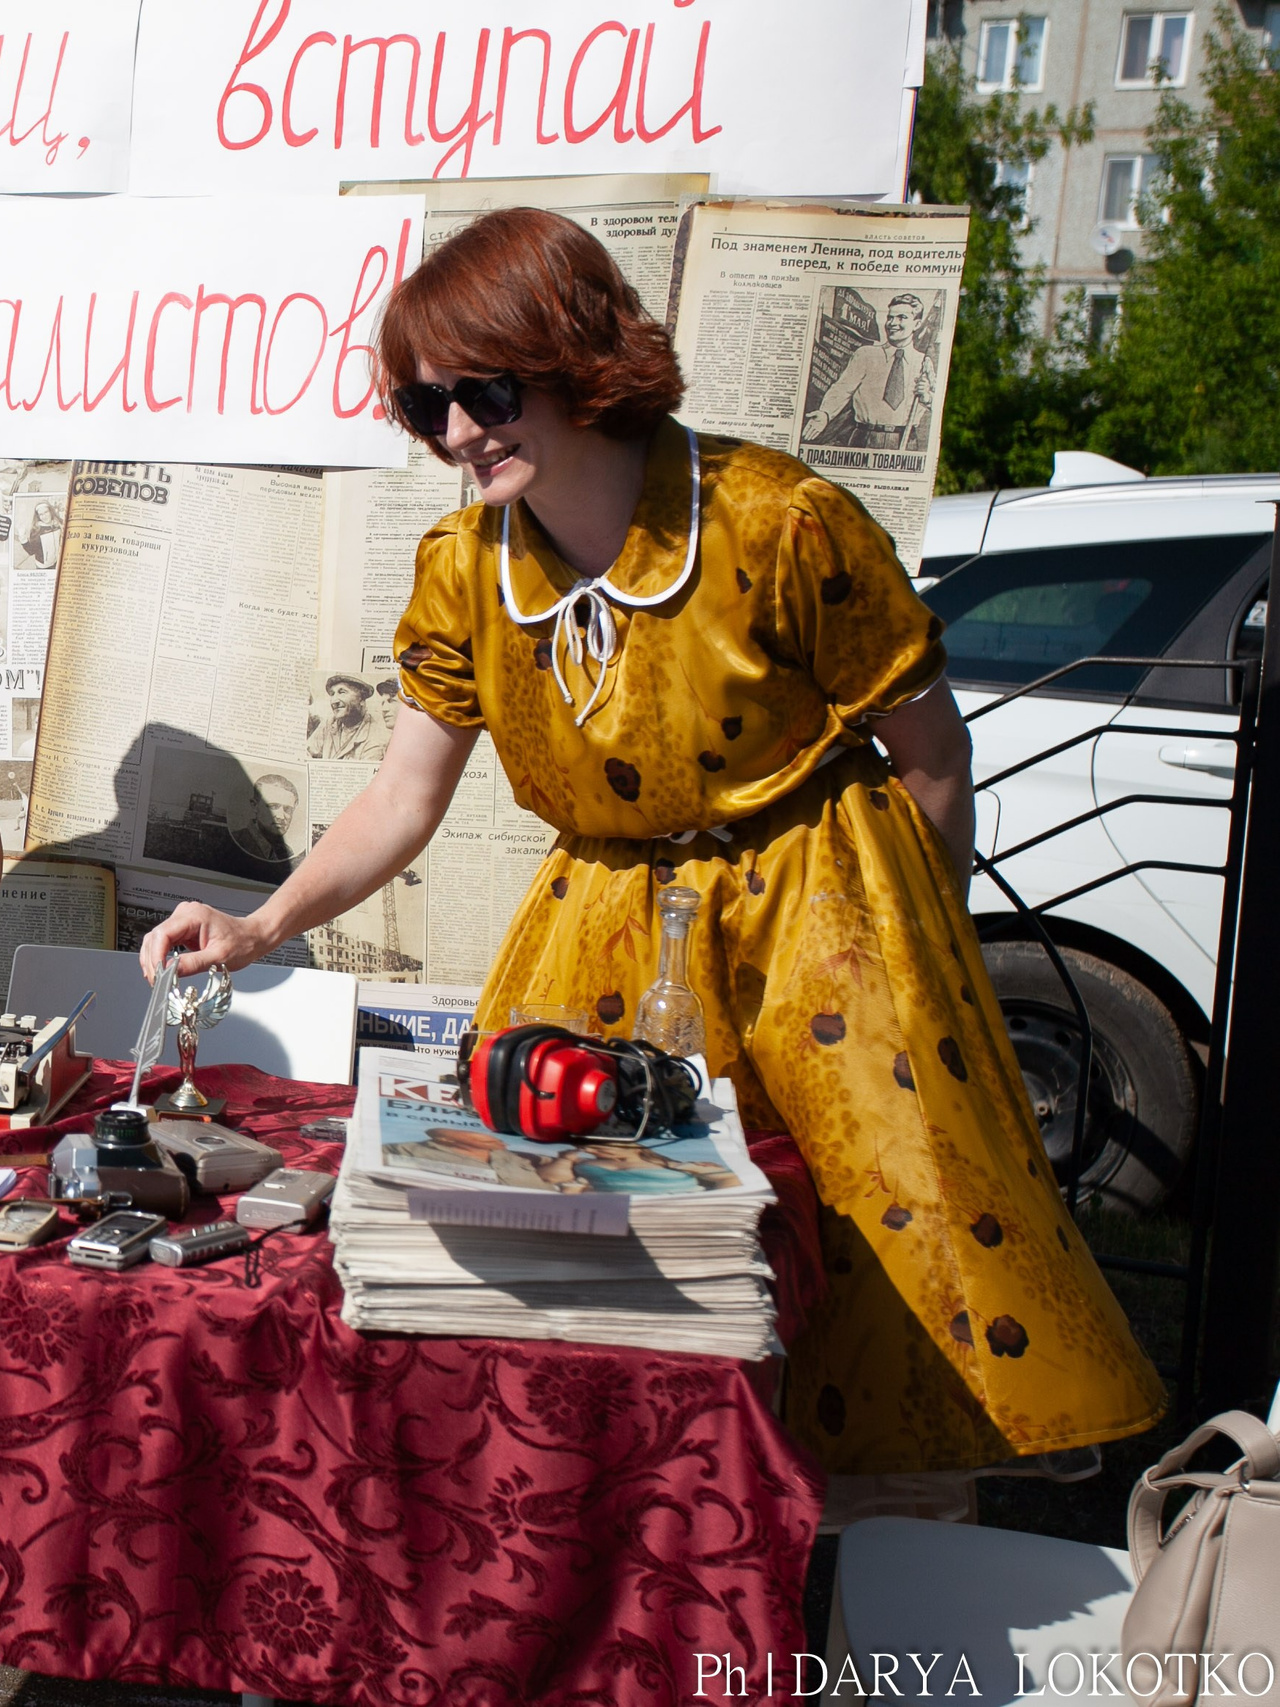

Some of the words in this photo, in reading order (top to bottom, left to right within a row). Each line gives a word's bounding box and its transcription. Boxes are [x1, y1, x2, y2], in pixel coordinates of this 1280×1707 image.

[216, 0, 723, 178] вступай
[590, 216, 598, 226] В
[603, 216, 653, 228] здоровом
[606, 226, 657, 239] здоровый
[711, 238, 738, 251] Под
[743, 242, 808, 254] знаменем
[810, 243, 864, 259] Ленина,
[868, 247, 894, 260] под
[780, 257, 831, 271] вперед,
[836, 261, 845, 271] к
[850, 261, 899, 273] победе
[728, 272, 756, 280] ответ
[806, 449, 870, 470] ПРАЗДНИКОМ,
[872, 452, 927, 473] ТОВАРИЩИ!
[73, 477, 170, 505] СОВЕТОВ
[270, 479, 301, 490] Высокая
[83, 531, 92, 539] за
[95, 533, 117, 543] вами,
[122, 537, 161, 551] товарищи
[81, 542, 140, 558] кукурузоводы
[239, 602, 261, 612] Когда
[277, 606, 299, 618] будет
[53, 754, 60, 762] Н.
[63, 756, 70, 764] С.
[441, 828, 483, 840] Экипаж
[488, 832, 547, 844] сибирской
[505, 846, 548, 856] закалки
[431, 995, 479, 1008] Здоровье
[357, 1011, 437, 1046] НЬКИЕ,
[414, 1046, 431, 1055] Что
[406, 1113, 482, 1128] самые
